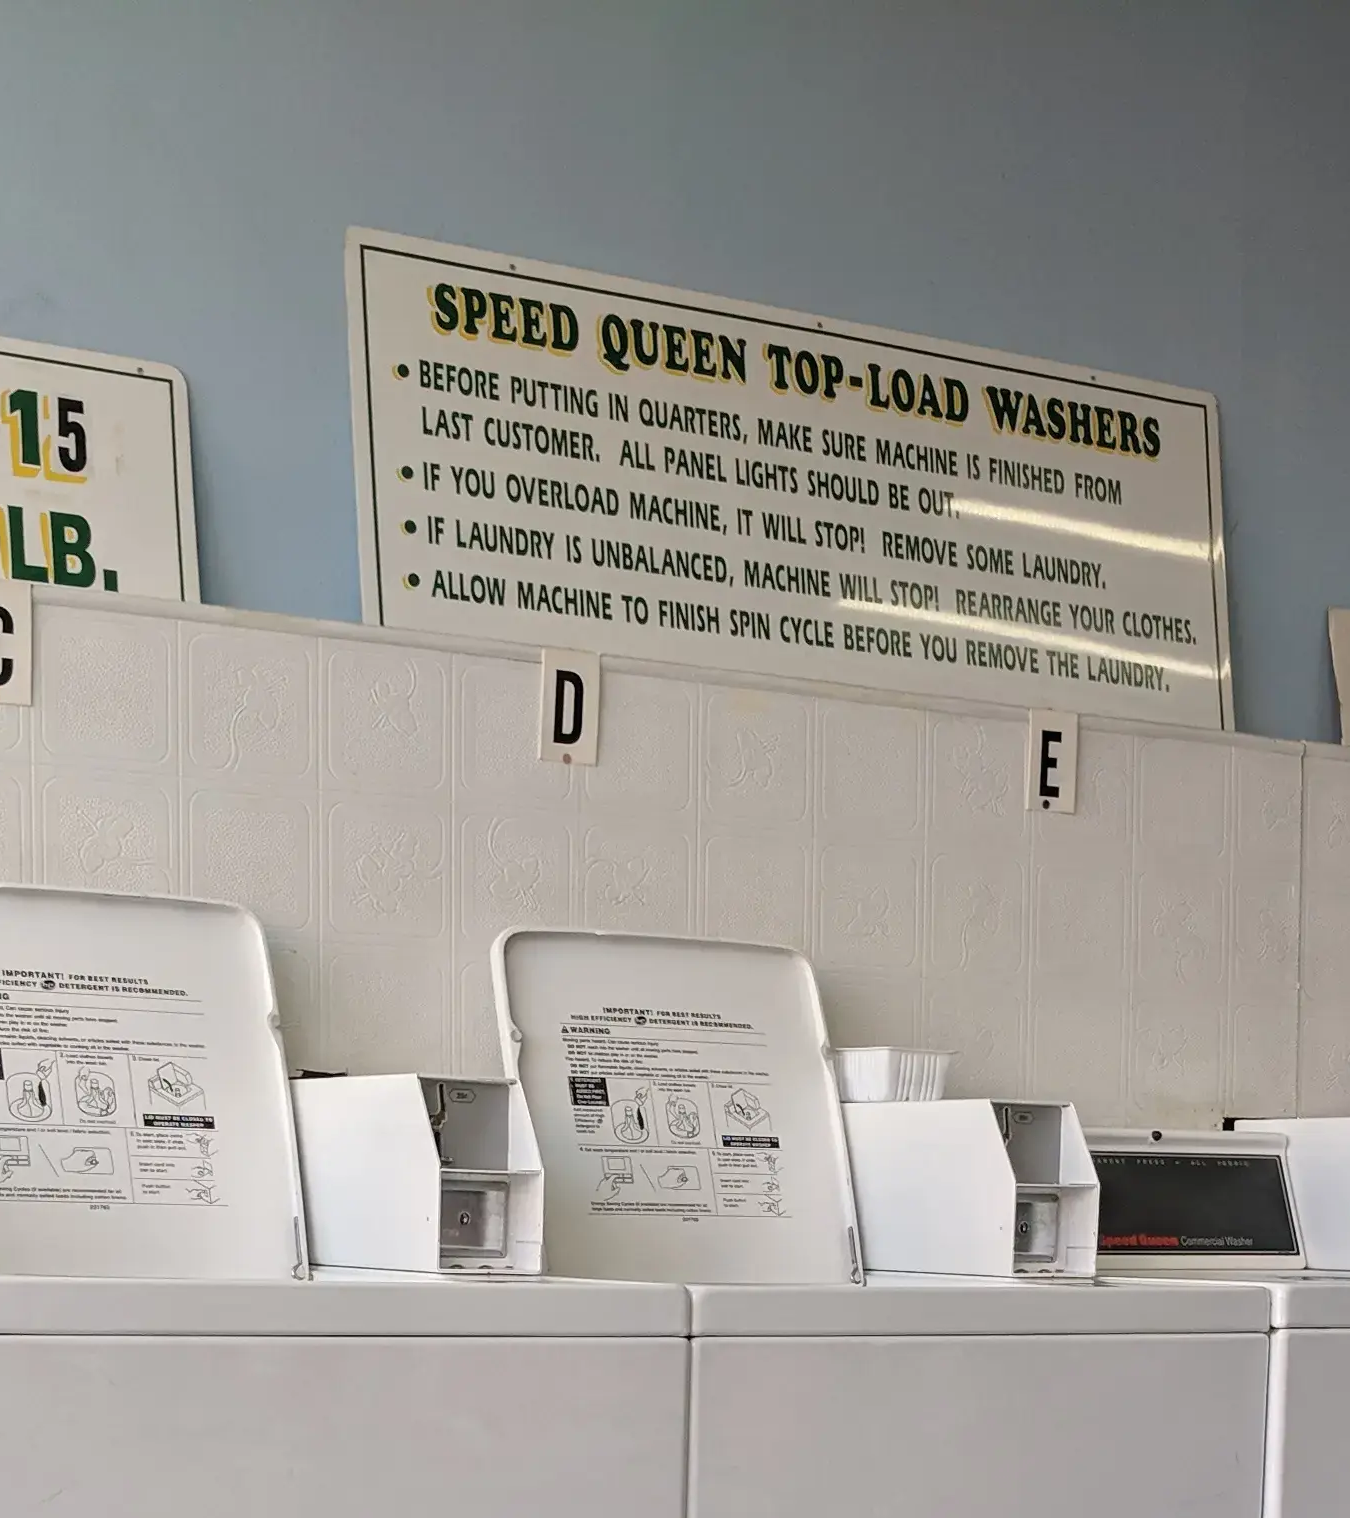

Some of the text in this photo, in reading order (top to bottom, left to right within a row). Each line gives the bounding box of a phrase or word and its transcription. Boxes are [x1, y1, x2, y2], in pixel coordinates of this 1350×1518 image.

[426, 282, 1160, 458] SPEED QUEEN TOP-LOAD WASHERS
[1, 388, 88, 480] 15
[418, 358, 1122, 505] BEFORE PUTTING IN QUARTERS, MAKE SURE MACHINE IS FINISHED FROM
[421, 405, 964, 520] LAST CUSTOMER. ALL PANEL LIGHTS SHOULD BE OUT.
[1, 504, 119, 593] LB.
[422, 461, 1106, 589] IF YOU OVERLOAD MACHINE, IT WILL STOP! REMOVE SOME LAUNDRY.
[427, 515, 1196, 645] IF LAUNDRY IS UNBALANCED, MACHINE WILL STOP! REARRANGE YOUR CLOTHES.
[431, 569, 1169, 692] ALLOW MACHINE TO FINISH SPIN CYCLE BEFORE YOU REMOVE THE LAUNDRY.
[552, 669, 584, 745] D
[1038, 730, 1063, 798] E
[2, 969, 65, 980] IMPORTANT!
[111, 977, 149, 985] RESULTS
[58, 983, 109, 991] DETERGENT
[570, 1027, 611, 1035] WARNING
[1180, 1236, 1224, 1246] Commercial
[1224, 1236, 1253, 1246] Washer
